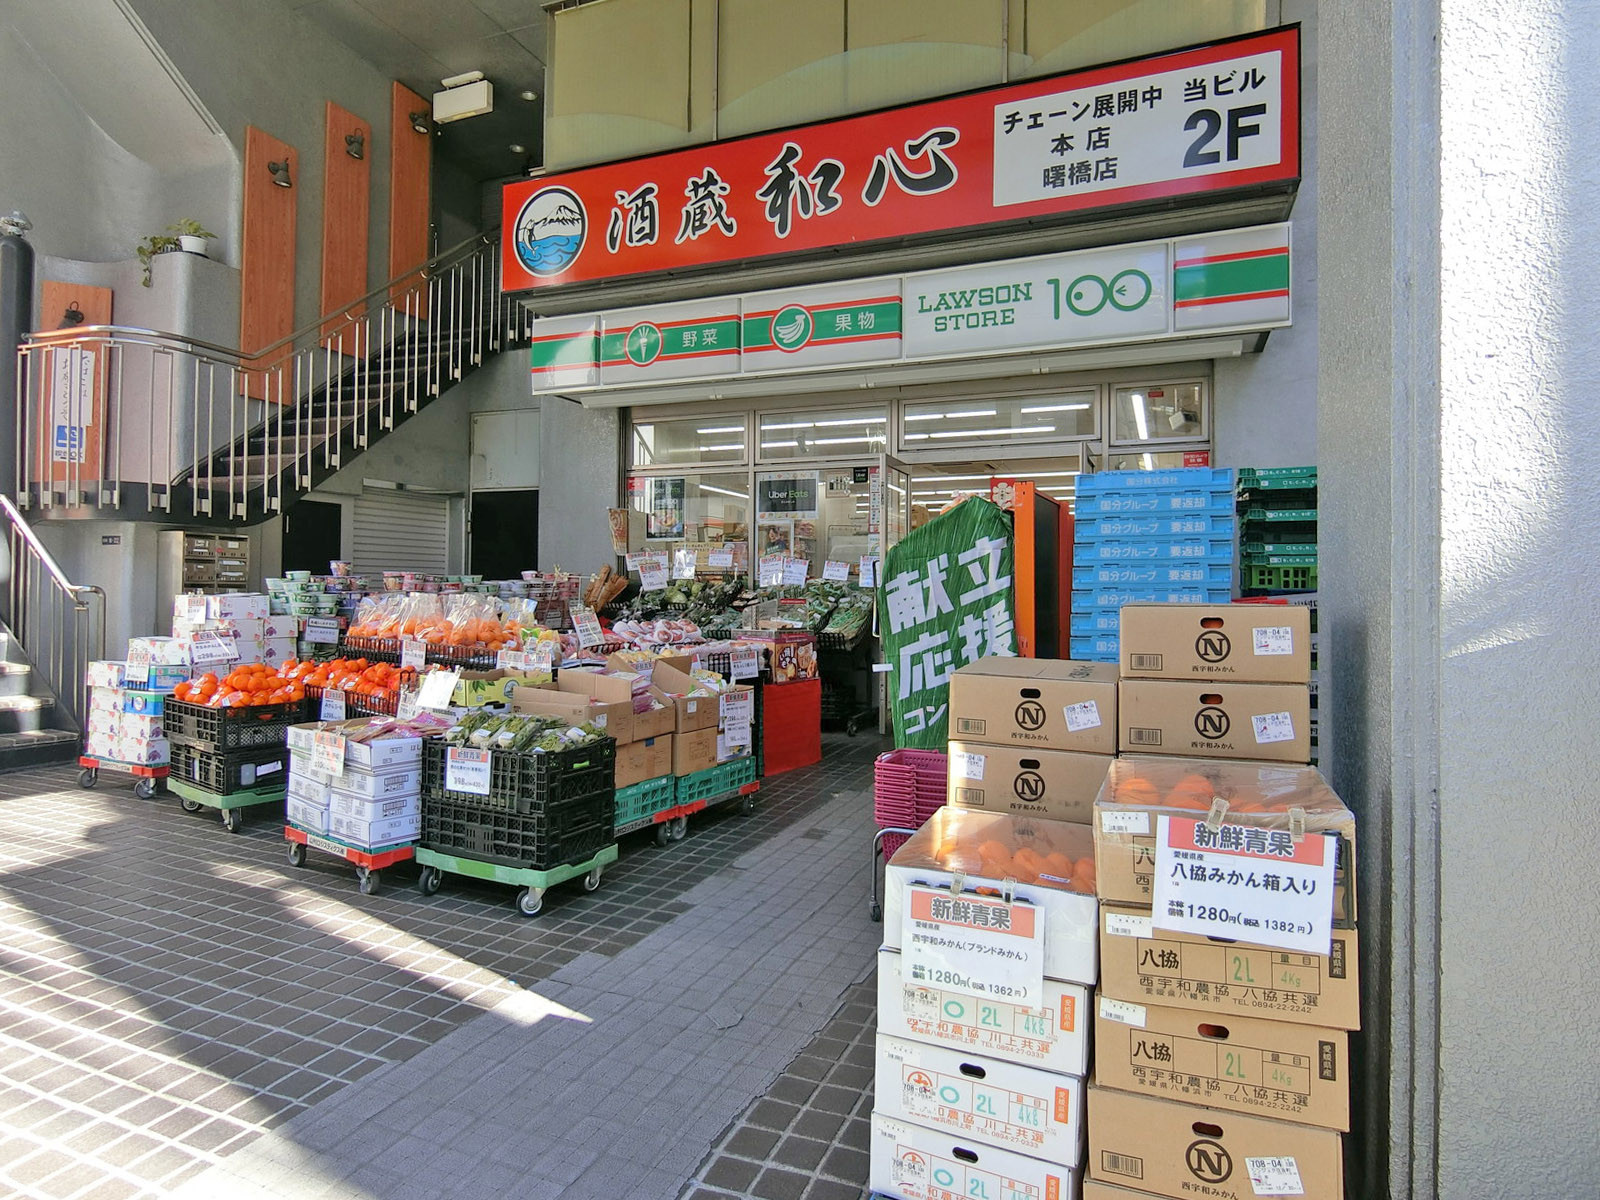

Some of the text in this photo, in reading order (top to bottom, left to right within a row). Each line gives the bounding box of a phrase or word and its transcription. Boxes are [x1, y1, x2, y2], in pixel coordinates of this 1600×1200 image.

[1183, 68, 1267, 103] 当ビル
[1003, 85, 1162, 135] チェーン展開中
[1182, 102, 1267, 168] 2F
[1043, 156, 1118, 190] 曙橋店
[918, 282, 1033, 314] LAWSON
[1046, 268, 1153, 320] 100
[834, 311, 876, 332] 果物
[934, 308, 1015, 332] STORE
[682, 328, 718, 348] 野菜
[768, 490, 809, 499] Uber Eats
[1101, 498, 1206, 511] 国分グループ 要返却
[1101, 522, 1206, 534] 国分グループ 要返却
[1100, 545, 1205, 558] 国分グループ 要返却
[885, 535, 1011, 634] 献立
[1099, 570, 1204, 581] 国分グループ 要返却
[899, 599, 1018, 700] 応援
[1192, 665, 1236, 673] 西宇和みかん
[1191, 741, 1235, 750] 西宇和みかん
[1194, 822, 1295, 857] 新鮮青果
[1170, 862, 1316, 896] 八協みかん箱入り
[932, 897, 1011, 930] 新鮮青果
[1140, 948, 1180, 969] 八協
[1233, 956, 1255, 983] 2L
[1232, 998, 1249, 1006] TEL
[1252, 1000, 1312, 1013] 0894-22-2242
[981, 1007, 1002, 1027] 2L
[1132, 1041, 1172, 1063] 八協
[1225, 1052, 1246, 1079] 2L
[976, 1094, 997, 1116] 2L
[1223, 1094, 1241, 1102] TEL
[1243, 1098, 1302, 1113] 0894-22-2242
[1181, 1181, 1239, 1200] 西宇和みかん
